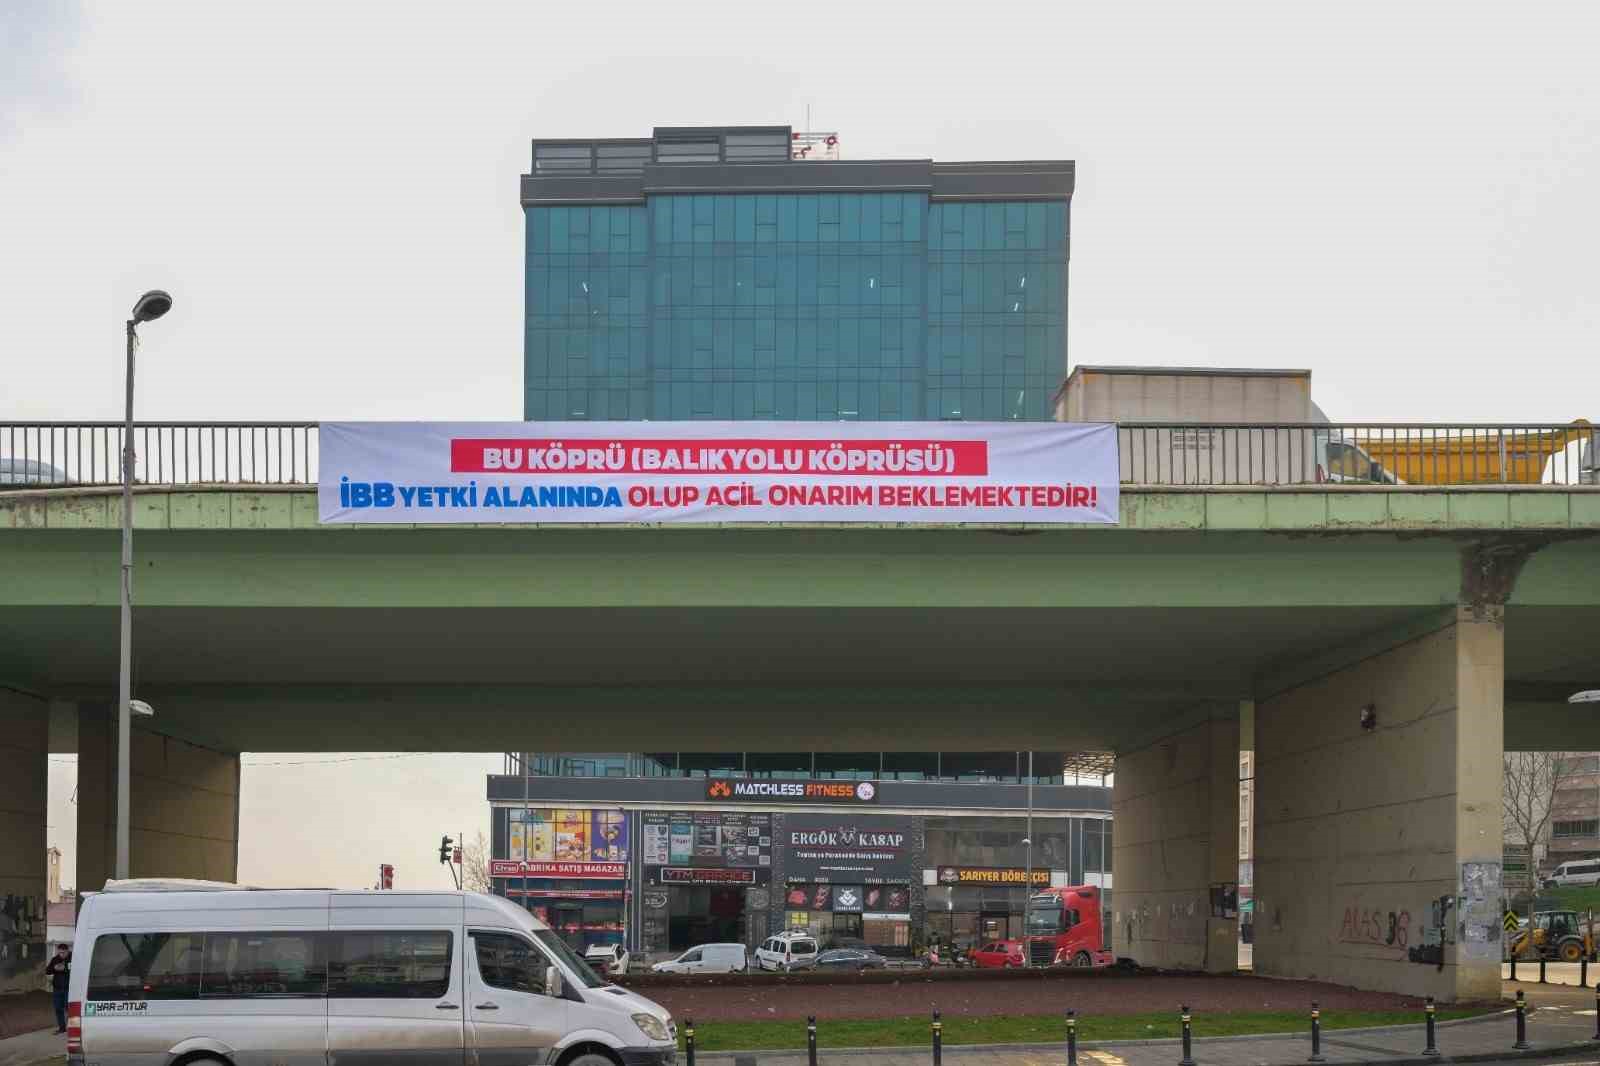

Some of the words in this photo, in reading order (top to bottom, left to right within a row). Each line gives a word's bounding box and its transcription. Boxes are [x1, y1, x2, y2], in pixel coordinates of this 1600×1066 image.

[483, 447, 522, 470] BU
[528, 441, 625, 470] KÖPRÜ
[631, 447, 802, 471] (BALIKYOLU
[808, 443, 955, 473] KÖPRÜSÜ)
[339, 476, 395, 508] İBB
[398, 481, 477, 507] YETKİ
[483, 486, 622, 507] ALANINDA
[628, 485, 699, 507] OLUP
[706, 481, 762, 506] ACİL
[768, 484, 873, 507] ONARIM
[878, 482, 1097, 507] BEKLEMEKTEDİR!
[735, 783, 803, 796] MATCHLESS
[806, 784, 854, 796] FITNESS
[791, 831, 837, 845] ERGÖK
[960, 871, 1000, 881] SARIYER
